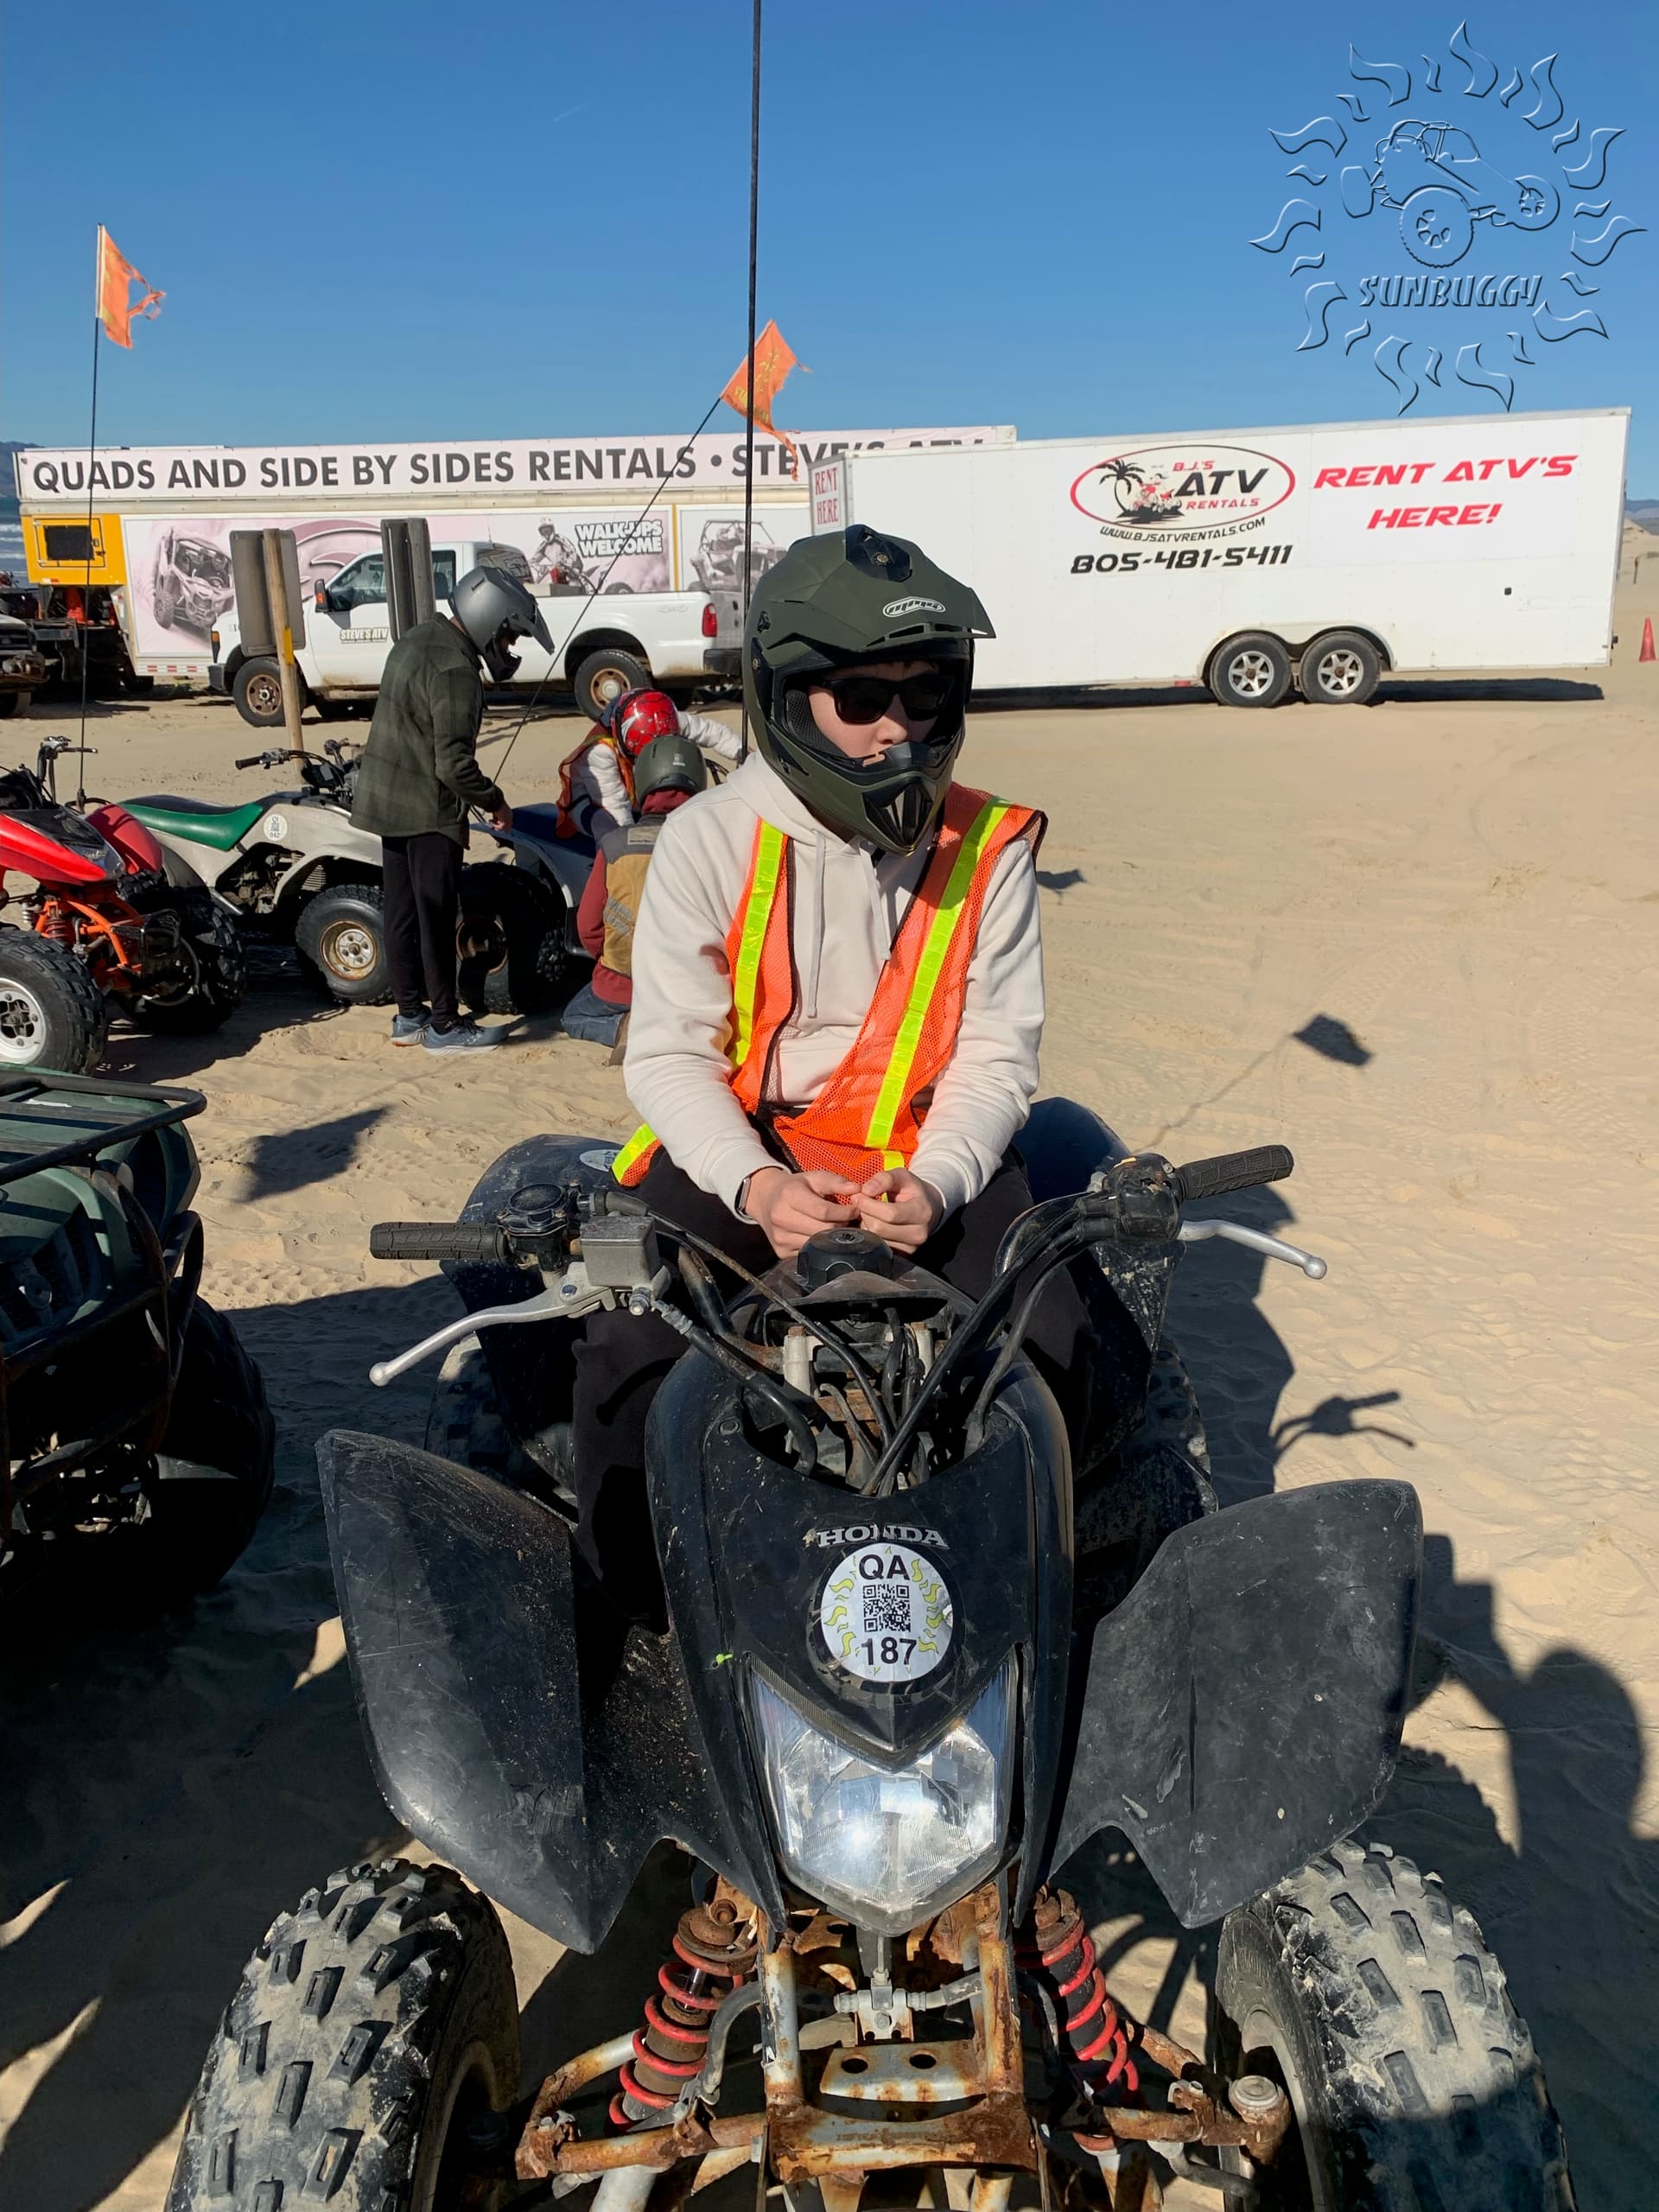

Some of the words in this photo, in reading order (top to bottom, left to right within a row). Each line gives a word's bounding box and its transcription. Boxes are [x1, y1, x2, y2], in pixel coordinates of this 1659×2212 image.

[34, 461, 156, 493] QUADS
[168, 459, 246, 489] AND
[260, 456, 339, 487] SIDE
[353, 454, 397, 486] BY
[410, 450, 514, 485] SIDES
[529, 446, 696, 481] RENTALS
[815, 467, 837, 495] RENT
[1174, 468, 1269, 497] ATV
[1313, 462, 1436, 489] RENT
[1441, 454, 1579, 482] ATV'S
[817, 499, 838, 525] HERE
[1186, 498, 1260, 510] RENTALS
[1367, 503, 1503, 530] HERE!
[575, 519, 663, 541] WALK-UPS
[1100, 517, 1266, 543] WWW.BJSATVRENTALS.COM
[578, 537, 663, 557] WELCOME
[1071, 544, 1294, 574] 805-481-5411
[372, 627, 388, 639] ATV
[818, 1525, 949, 1547] HONDA
[859, 1554, 910, 1580] QA
[861, 1637, 917, 1665] 187
